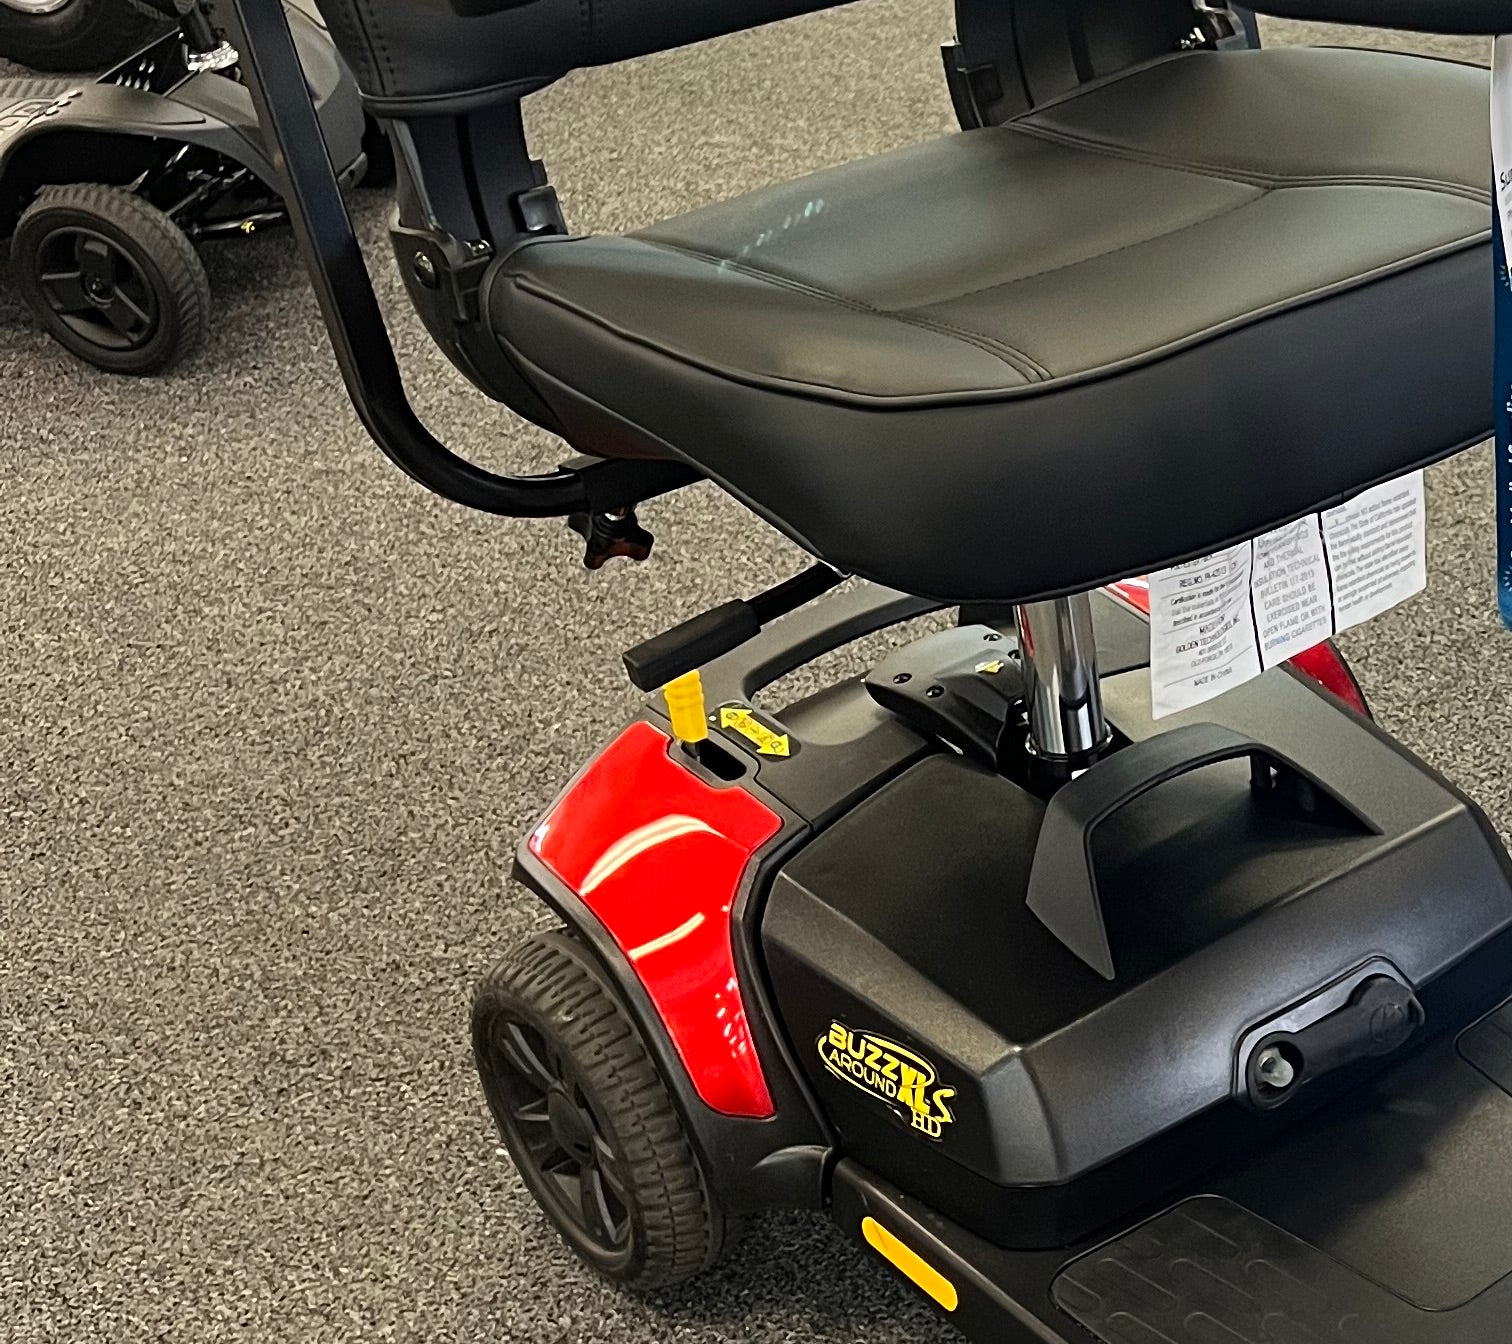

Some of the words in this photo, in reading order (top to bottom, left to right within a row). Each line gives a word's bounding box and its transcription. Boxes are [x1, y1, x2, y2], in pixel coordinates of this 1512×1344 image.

[1176, 639, 1199, 654] GOLDEN
[828, 1022, 901, 1081] BUZZ
[829, 1049, 897, 1099] AROUND
[910, 1107, 942, 1138] HD
